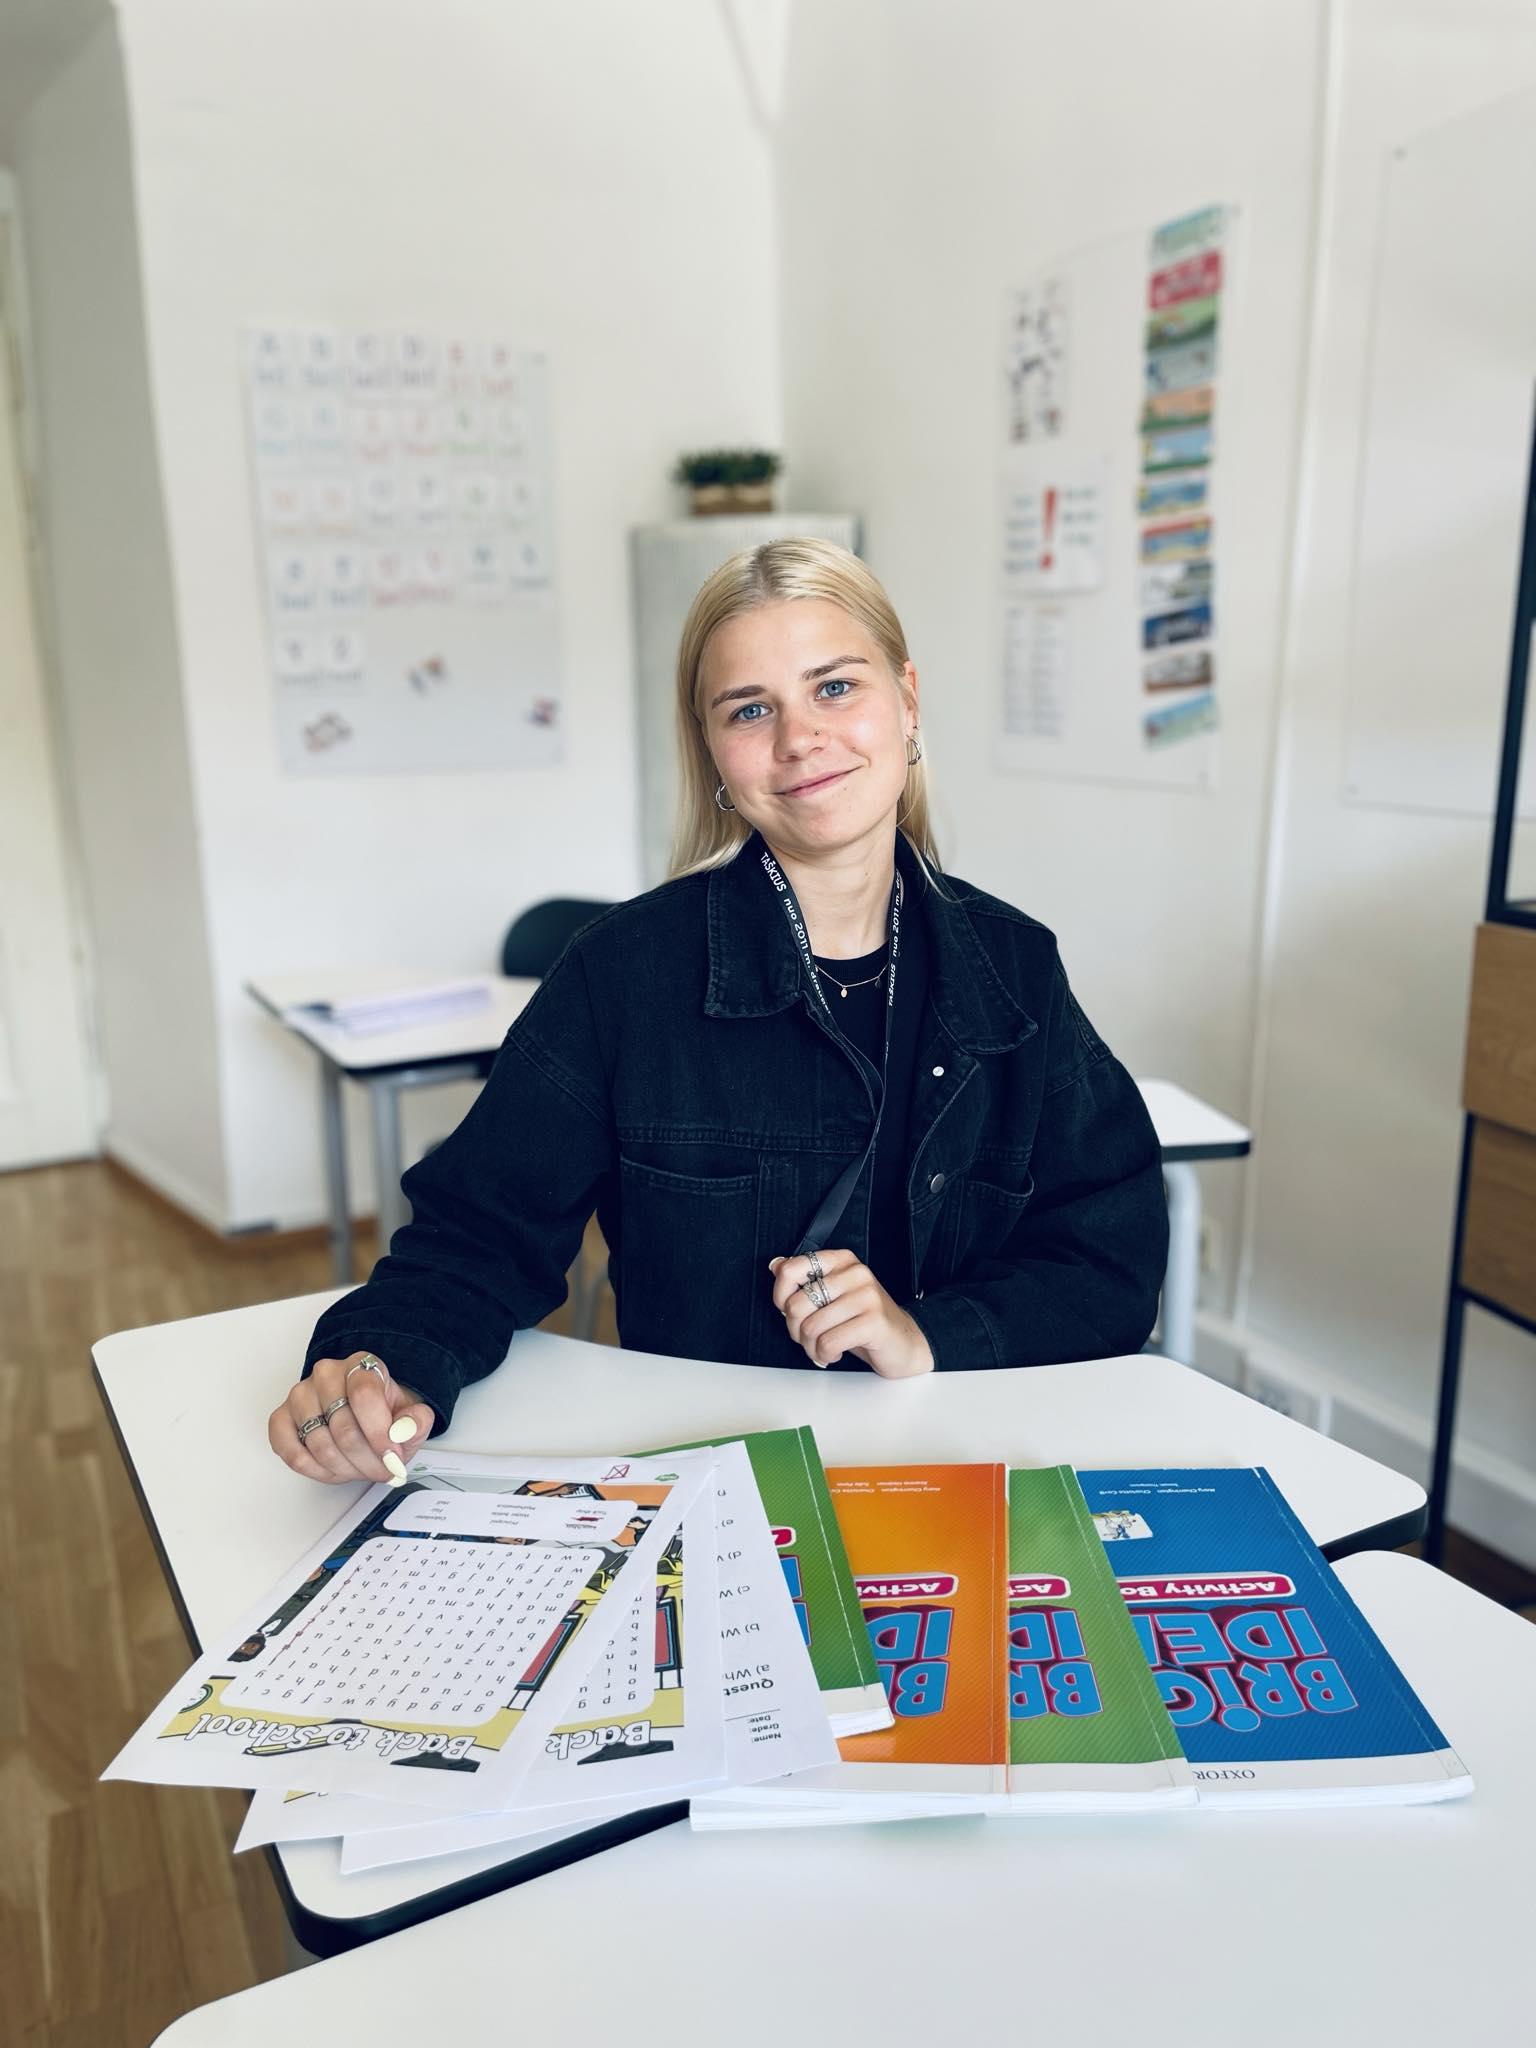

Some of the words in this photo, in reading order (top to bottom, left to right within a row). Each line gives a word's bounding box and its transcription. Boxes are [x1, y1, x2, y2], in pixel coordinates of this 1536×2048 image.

[760, 851, 787, 892] TAŠKIUS
[784, 898, 797, 921] nuo
[795, 922, 809, 950] 2011
[804, 953, 814, 968] m.
[888, 963, 896, 1006] TAŠKIUS
[892, 907, 900, 934] 2011
[721, 1519, 734, 1528] e)
[728, 1551, 742, 1560] d)
[737, 1585, 750, 1595] c)
[1164, 1580, 1276, 1596] Activity
[745, 1623, 760, 1633] b)
[756, 1664, 770, 1675] a)
[723, 1678, 774, 1696] Quest
[746, 1715, 771, 1724] Date:
[186, 1714, 319, 1750] School
[749, 1723, 779, 1733] Grade:
[327, 1728, 368, 1754] to
[378, 1728, 477, 1761] Back
[546, 1720, 651, 1760] Back
[751, 1733, 781, 1743] Name:
